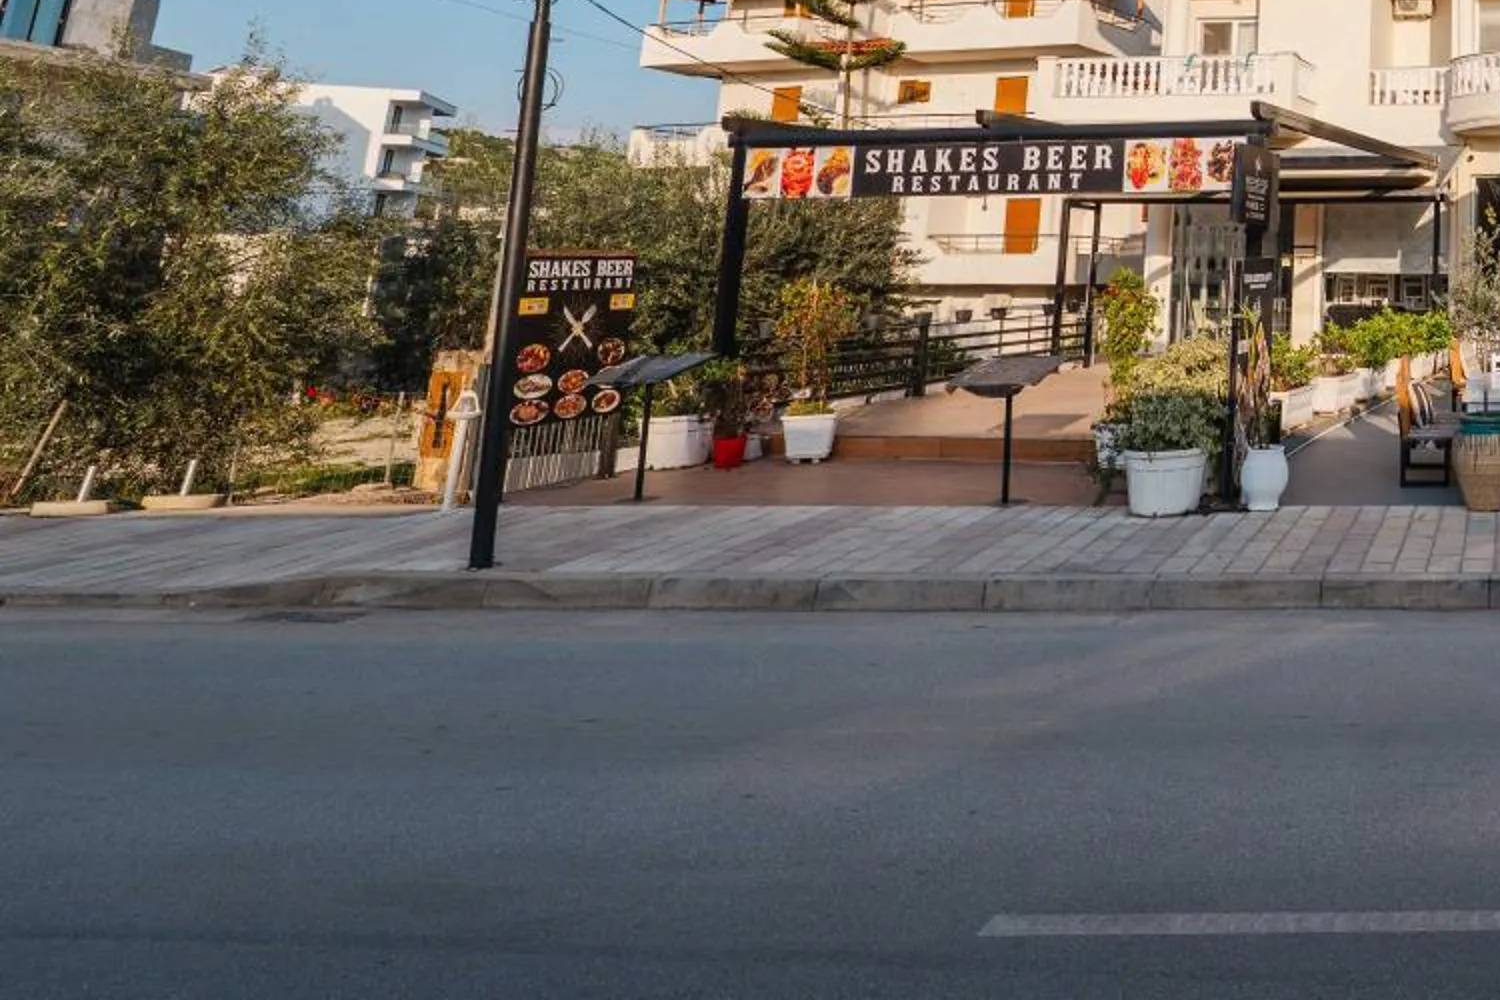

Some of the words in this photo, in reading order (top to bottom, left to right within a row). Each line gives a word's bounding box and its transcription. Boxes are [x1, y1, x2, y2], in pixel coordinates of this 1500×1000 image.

[865, 146, 999, 174] SHAKES
[1022, 144, 1114, 171] BEER
[892, 173, 1082, 193] RESTAURANT
[529, 260, 591, 277] SHAKES
[597, 260, 633, 275] BEER
[527, 277, 632, 291] RESTAURANT
